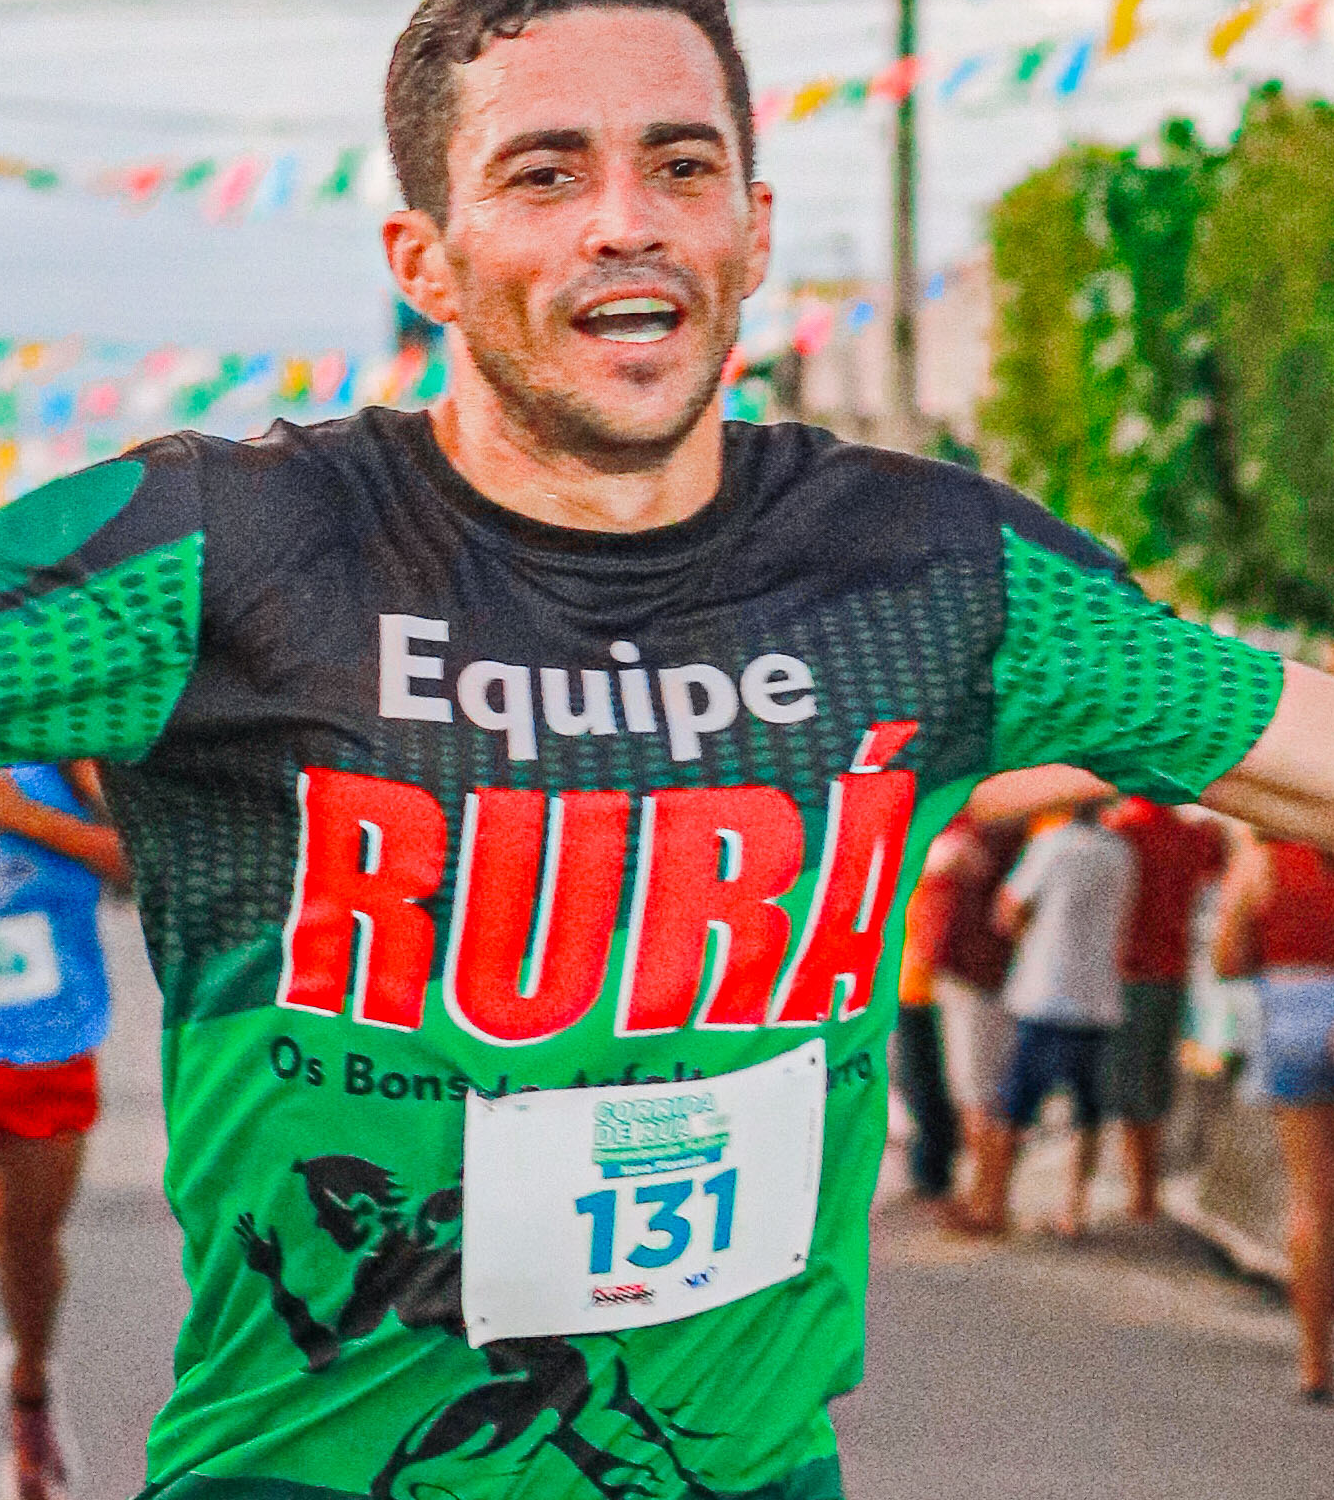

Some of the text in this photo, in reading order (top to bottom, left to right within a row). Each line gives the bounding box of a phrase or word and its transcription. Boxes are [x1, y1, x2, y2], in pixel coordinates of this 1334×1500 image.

[378, 613, 818, 763] Equipe
[277, 720, 919, 1047] RURÁ
[270, 1035, 325, 1087] Os
[344, 1051, 471, 1102] Bons
[593, 1122, 631, 1147] DE
[574, 1167, 739, 1276] 131
